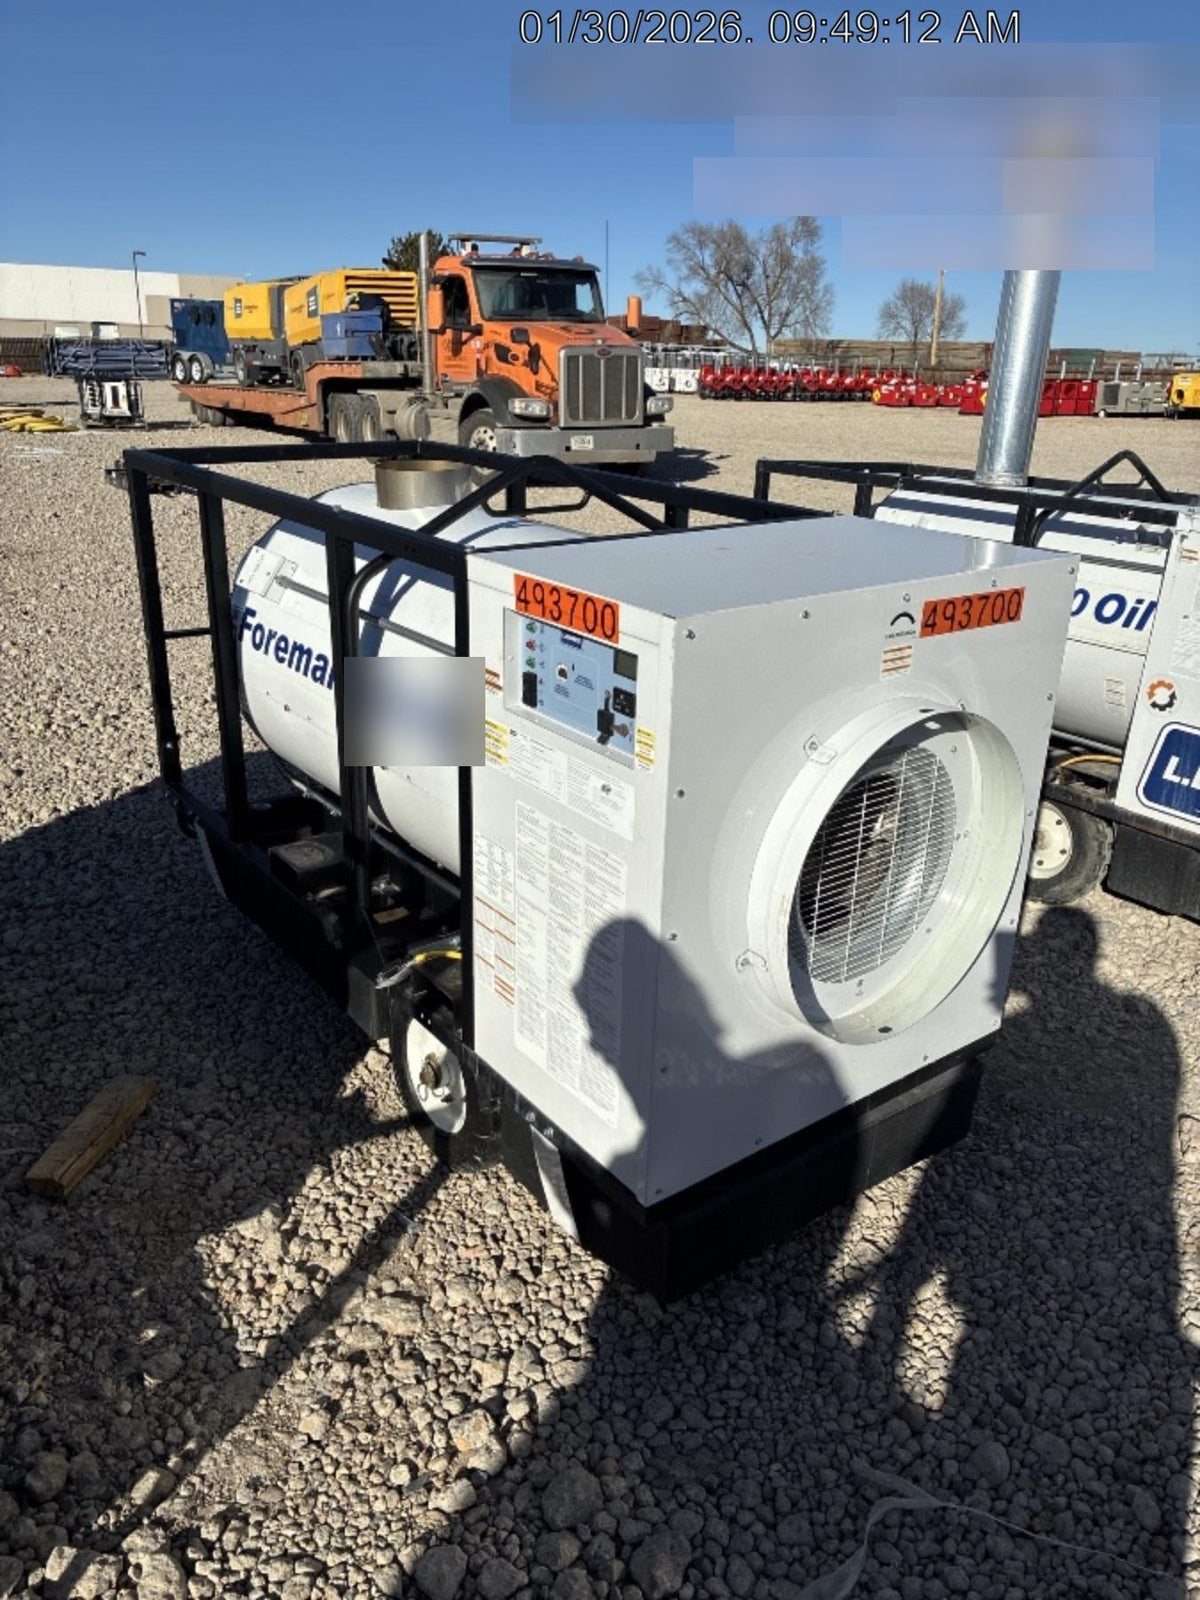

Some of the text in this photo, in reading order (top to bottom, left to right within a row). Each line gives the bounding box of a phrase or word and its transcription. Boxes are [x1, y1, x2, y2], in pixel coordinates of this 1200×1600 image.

[516, 580, 618, 639] 493700
[923, 590, 1022, 634] 493700
[1094, 593, 1158, 631] Oil
